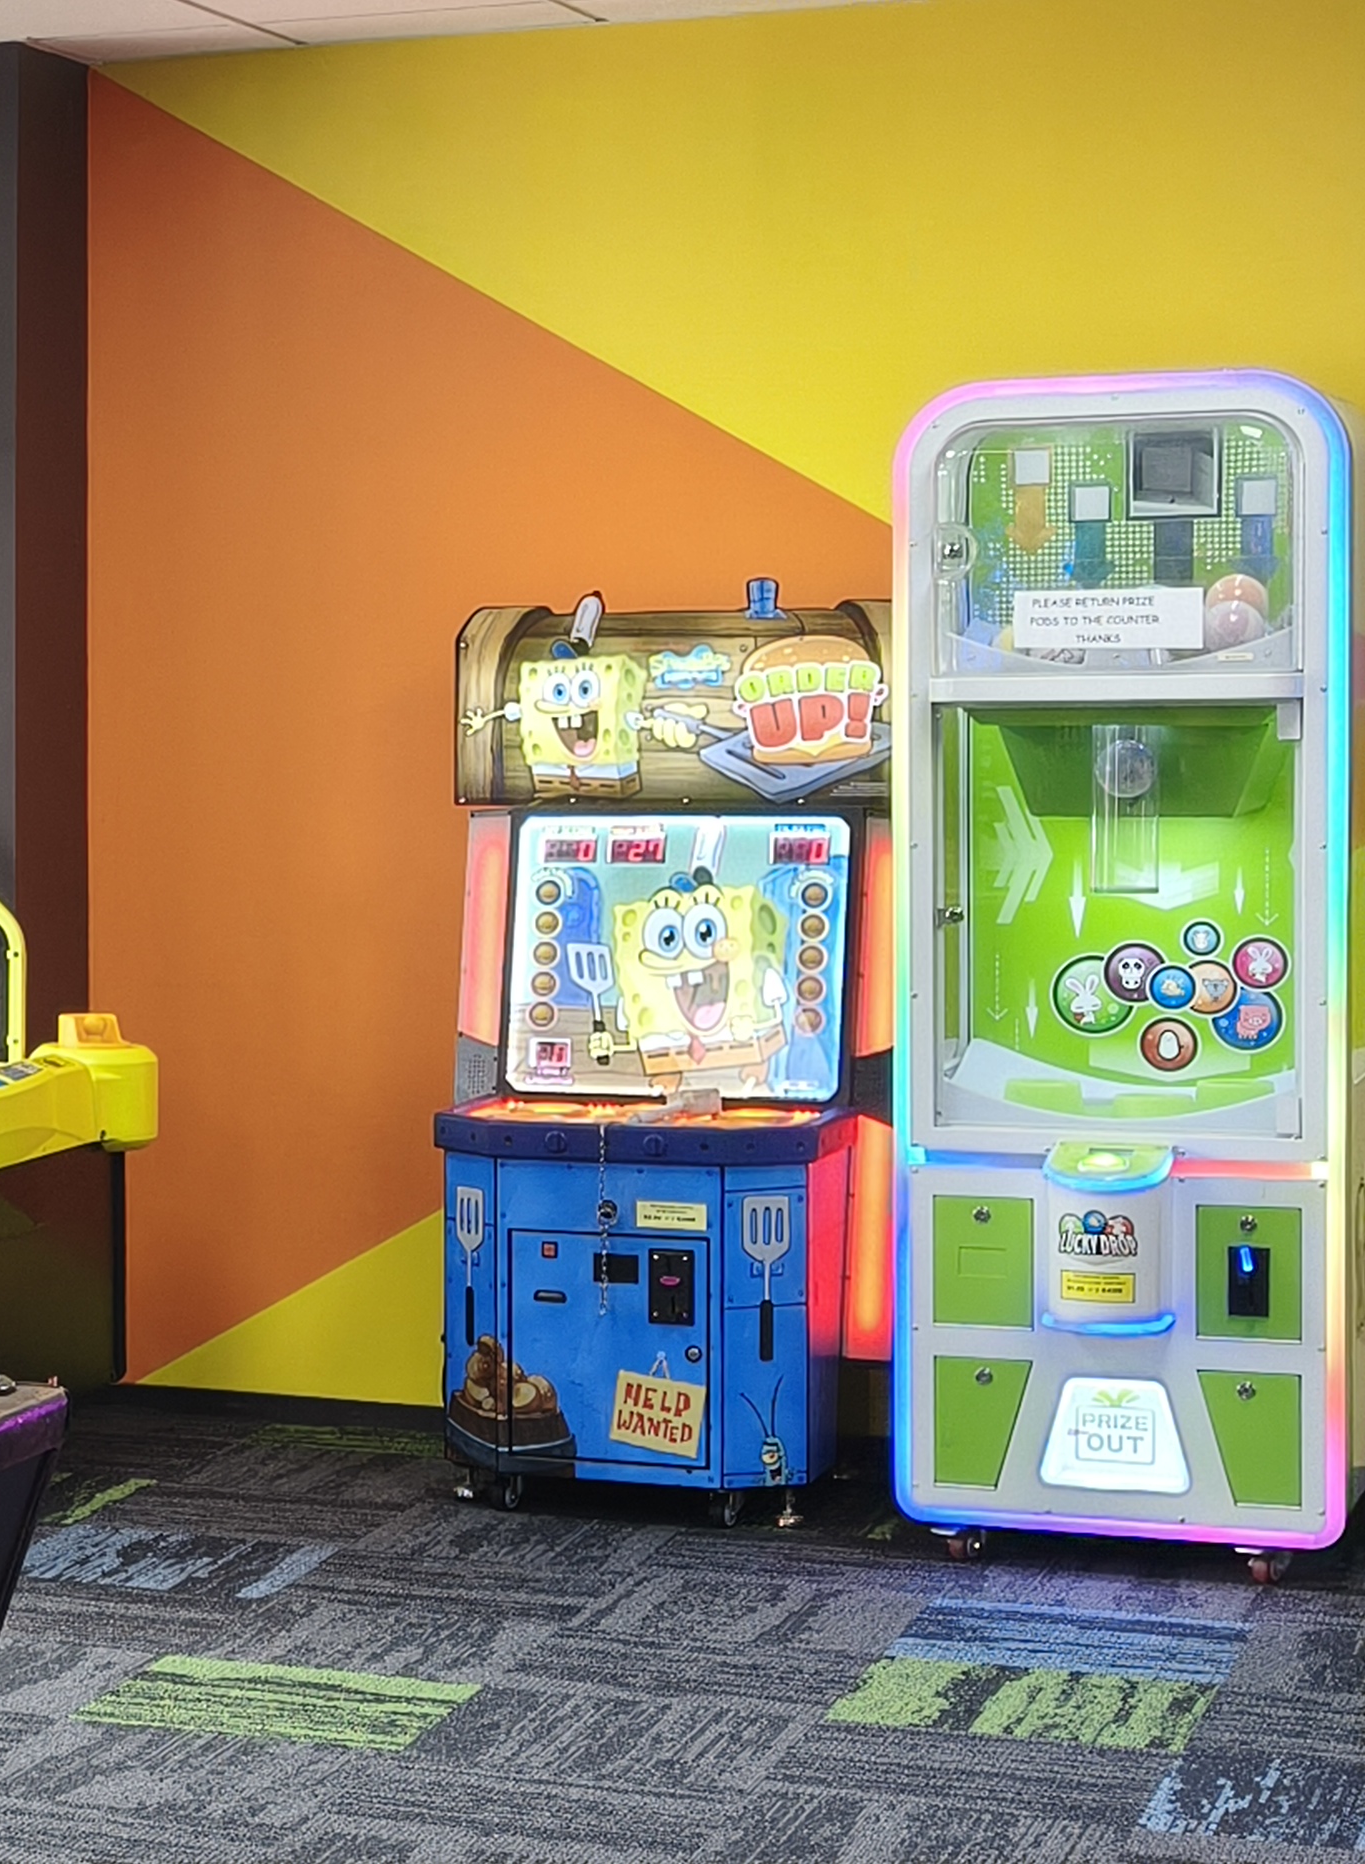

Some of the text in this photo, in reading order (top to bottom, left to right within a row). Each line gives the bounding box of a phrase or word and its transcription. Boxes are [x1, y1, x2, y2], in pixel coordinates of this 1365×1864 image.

[1032, 595, 1155, 608] PLEASE RETURN PRIZE
[1030, 614, 1160, 627] PODS TO THE COUNTER
[1075, 634, 1121, 644] THANKS
[739, 663, 876, 702] ORDER
[749, 691, 871, 748] UP!
[1058, 1229, 1138, 1258] LUCKY DROP
[623, 1382, 691, 1417] HELP
[616, 1408, 693, 1444] WANTED
[1082, 1412, 1148, 1432] PRIZE
[1086, 1432, 1145, 1455] OUT
